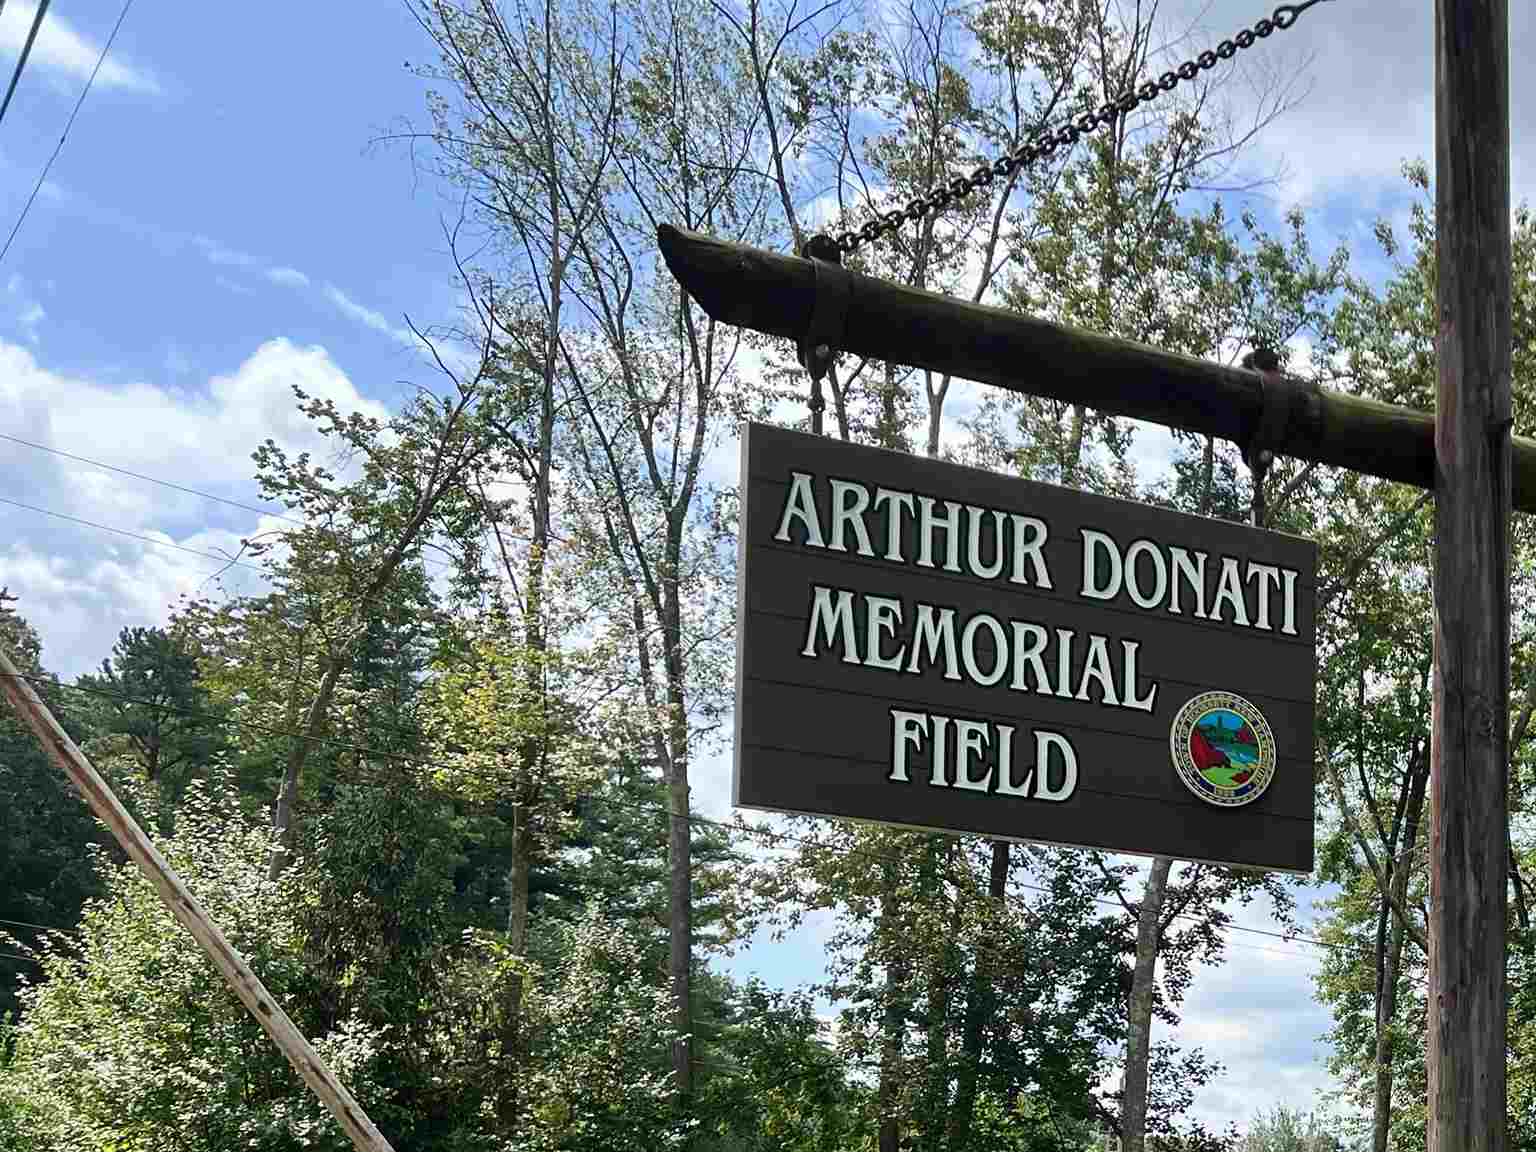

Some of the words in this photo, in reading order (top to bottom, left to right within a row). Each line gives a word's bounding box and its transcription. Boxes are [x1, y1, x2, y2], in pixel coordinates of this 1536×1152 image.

[774, 471, 1053, 590] ARTHUR
[1079, 528, 1300, 635] DONATI
[801, 585, 1158, 713] MEMORIAL
[888, 709, 1078, 802] FIELD
